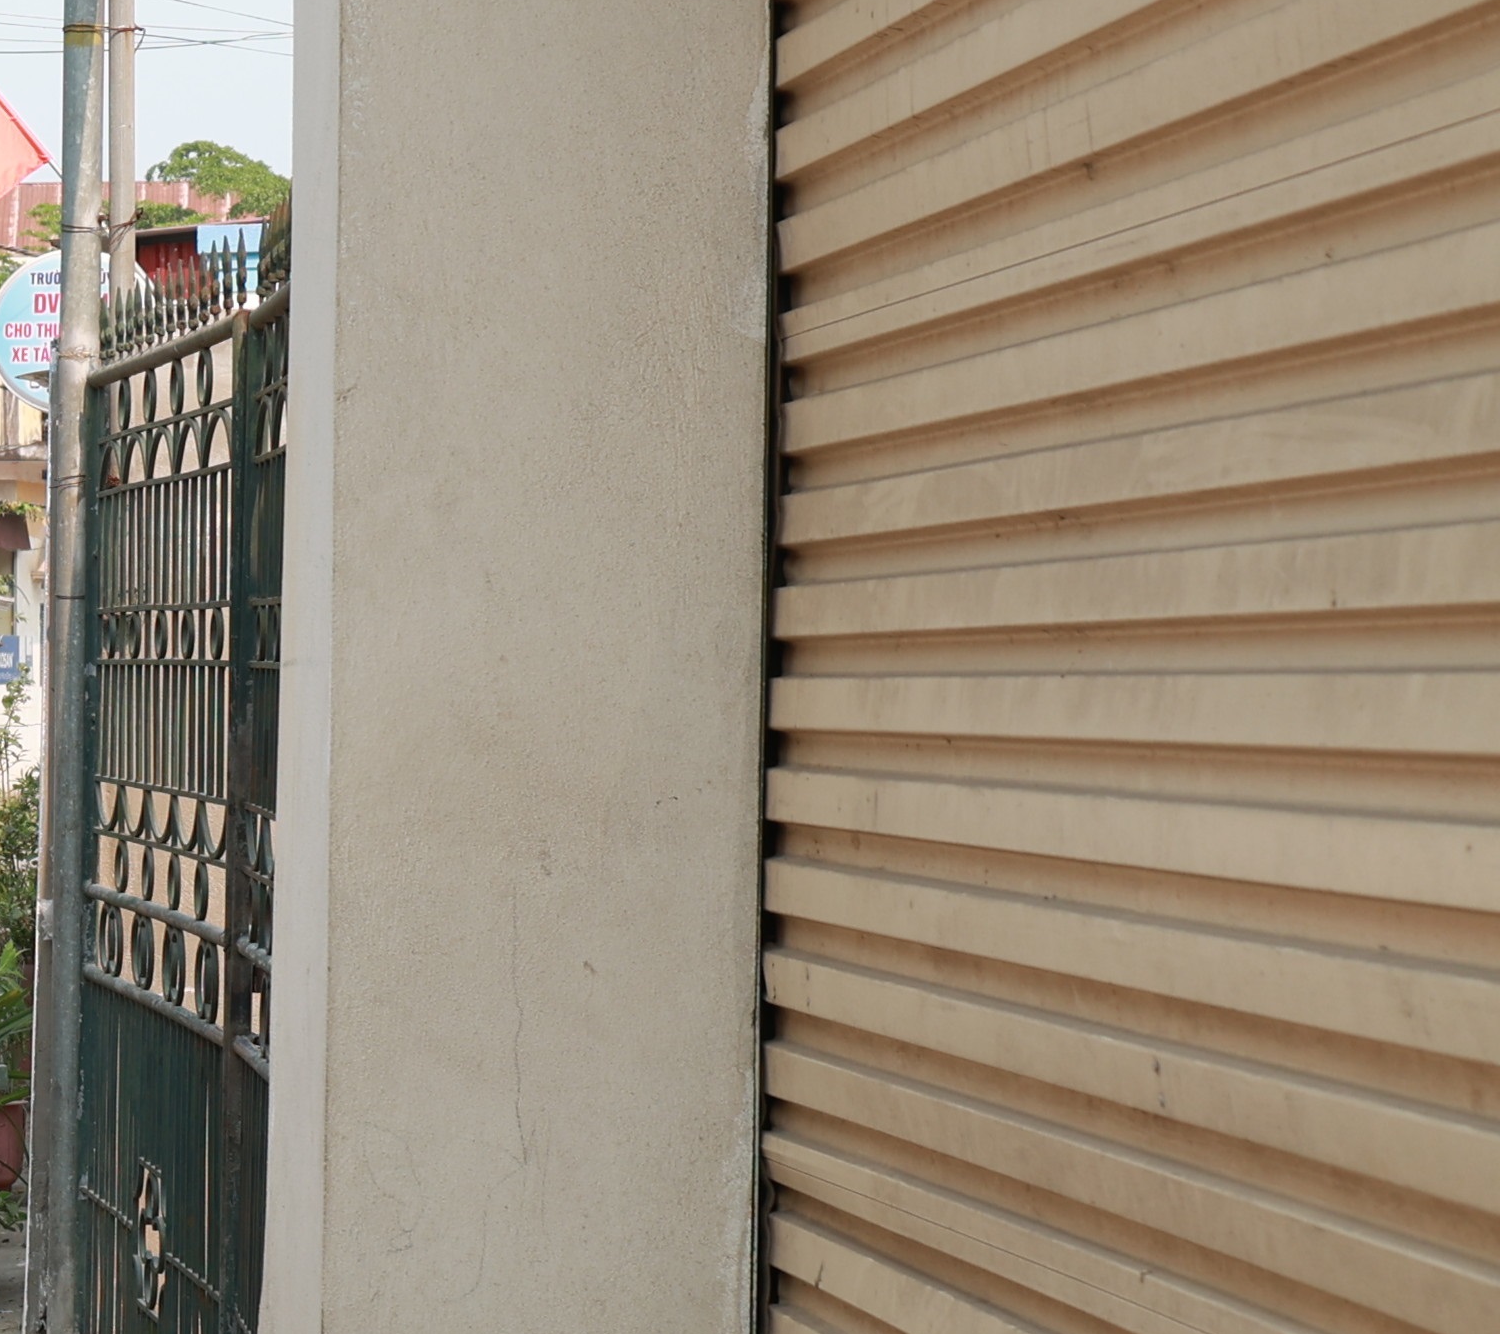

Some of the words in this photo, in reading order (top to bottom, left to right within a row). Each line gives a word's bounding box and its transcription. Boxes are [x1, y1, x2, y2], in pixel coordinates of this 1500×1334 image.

[5, 323, 32, 338] CHO
[36, 323, 61, 338] THU
[12, 347, 29, 363] XE
[33, 342, 51, 363] TẢ
